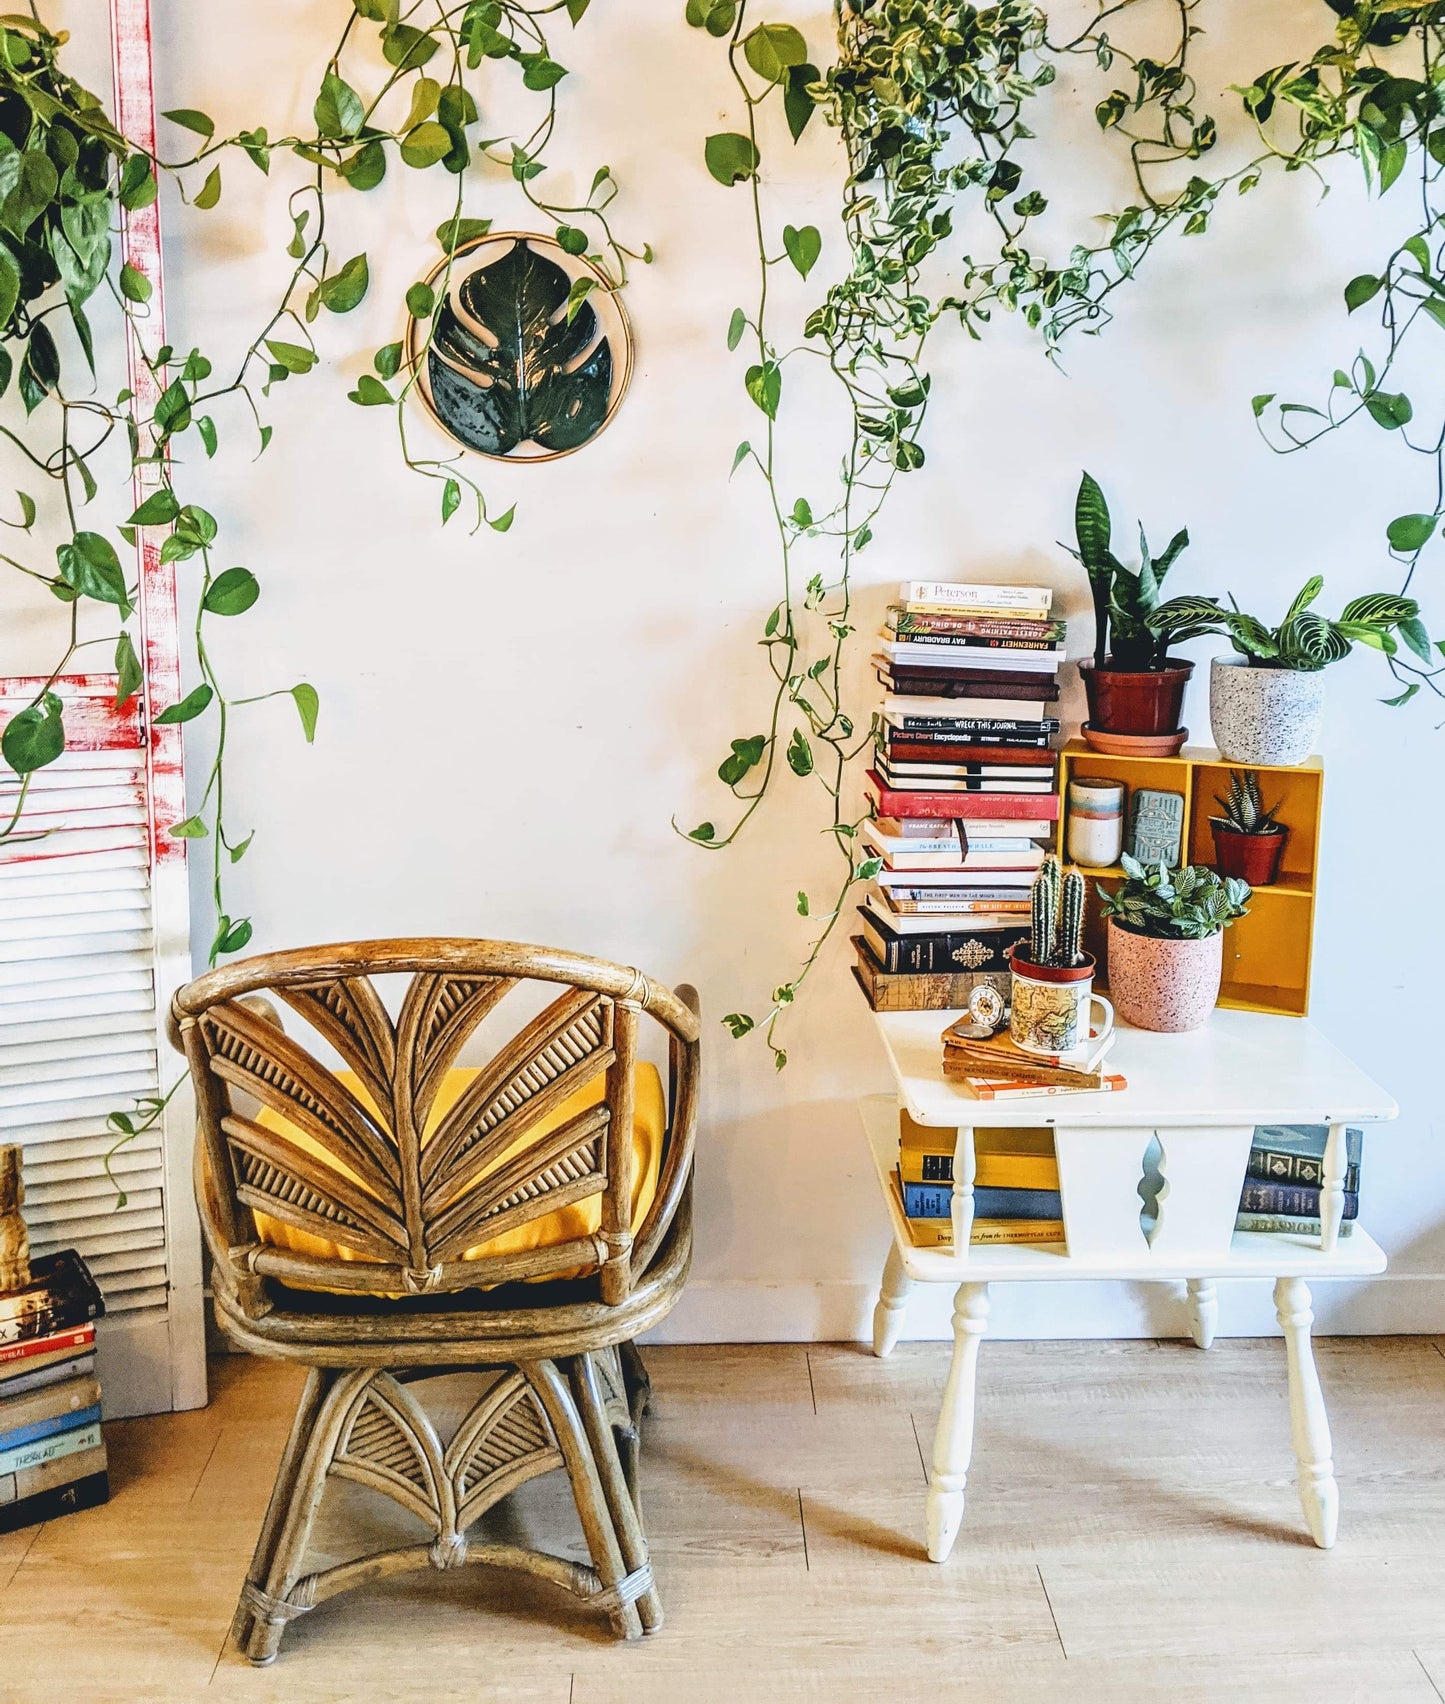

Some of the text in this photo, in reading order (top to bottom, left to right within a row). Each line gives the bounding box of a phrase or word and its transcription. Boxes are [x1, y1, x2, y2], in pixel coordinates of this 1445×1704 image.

[934, 585, 978, 599] Peterson
[913, 636, 950, 644] BRADBURY
[1001, 640, 1048, 649] FAHRENHEIT
[976, 721, 991, 729] THIS
[934, 733, 971, 741] Encyclopedia
